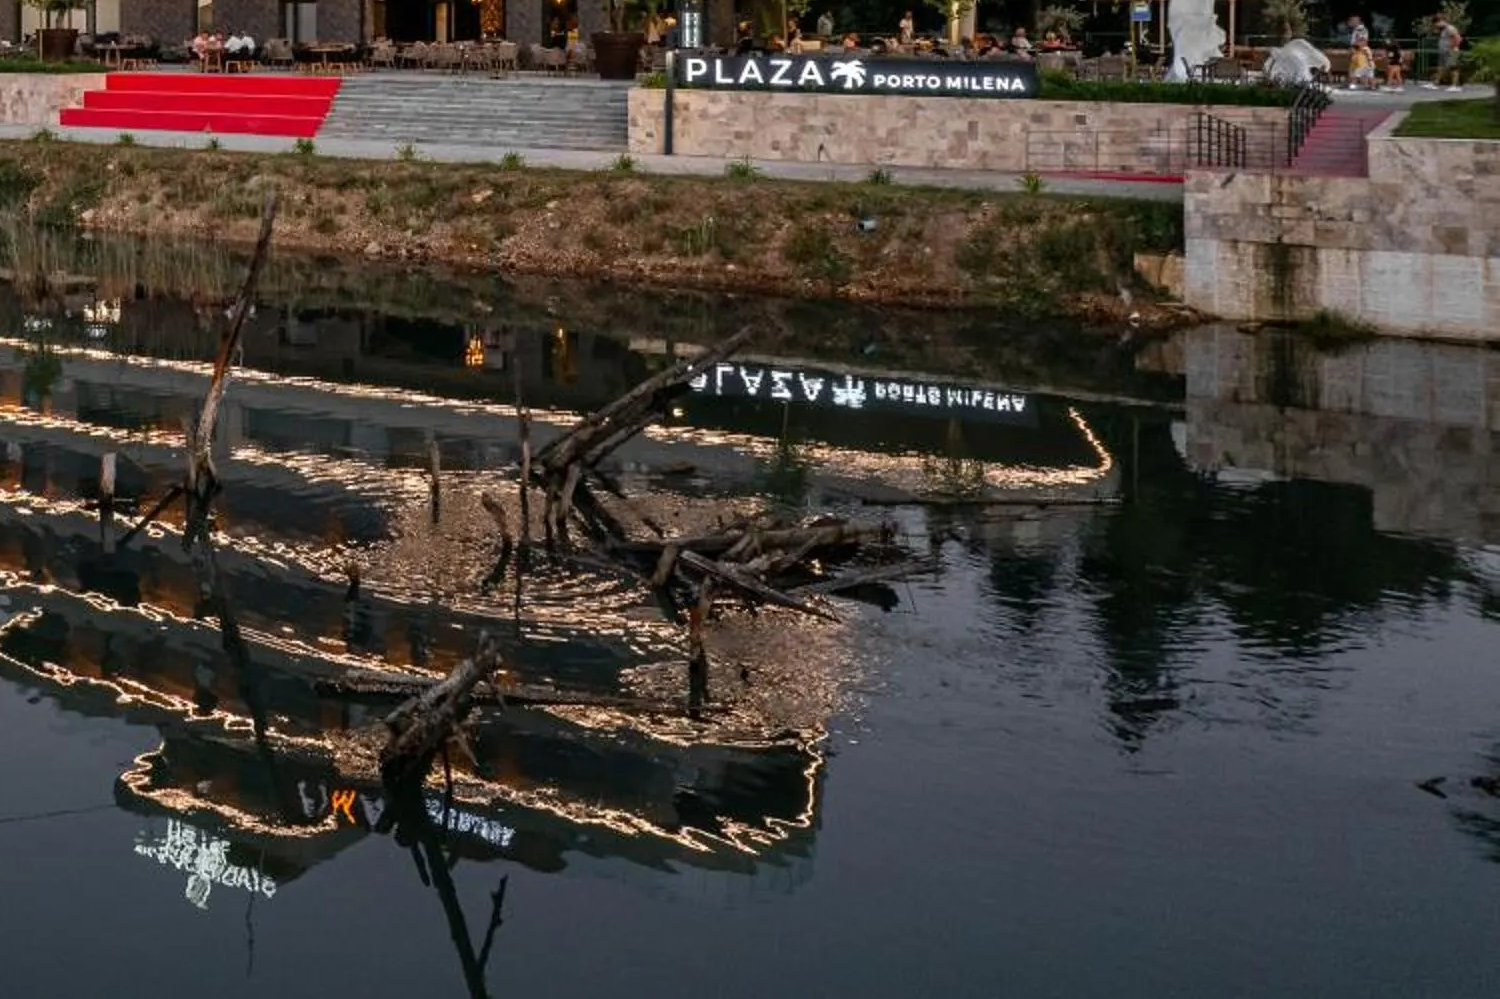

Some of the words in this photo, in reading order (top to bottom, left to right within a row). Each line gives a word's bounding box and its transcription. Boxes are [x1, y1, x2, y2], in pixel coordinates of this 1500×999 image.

[685, 58, 825, 86] PLAZA
[873, 73, 942, 89] PORTO
[945, 75, 1026, 92] MILENA
